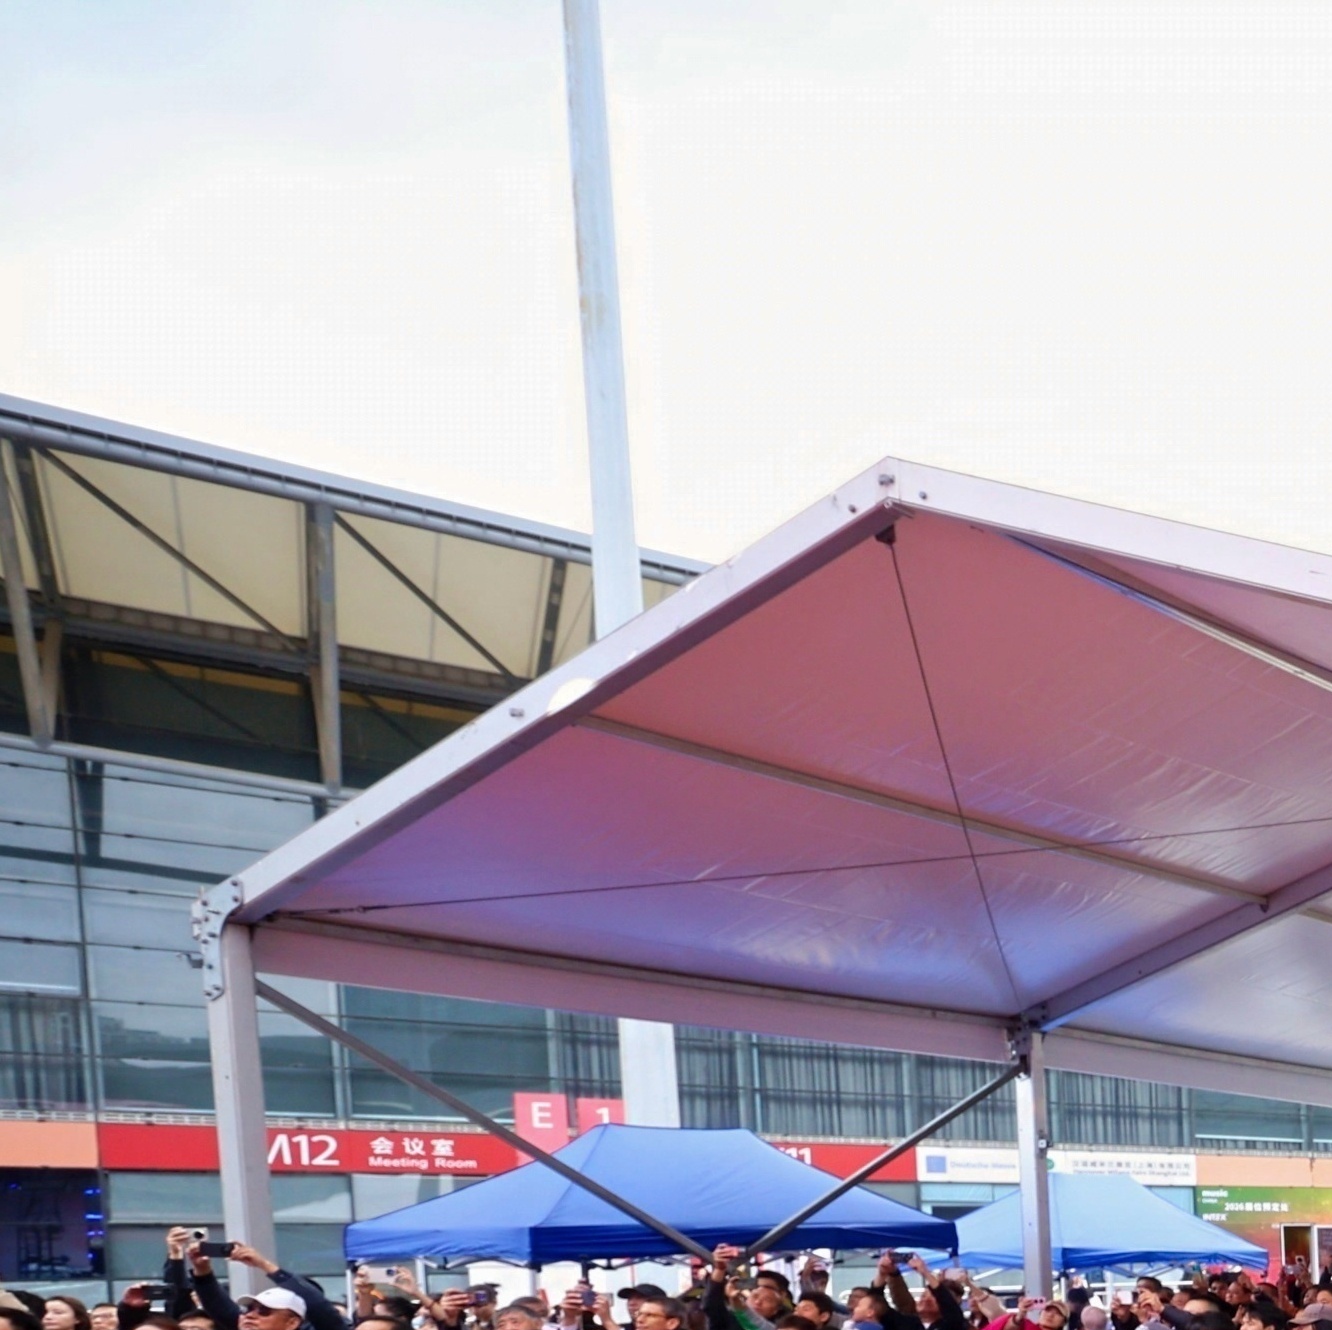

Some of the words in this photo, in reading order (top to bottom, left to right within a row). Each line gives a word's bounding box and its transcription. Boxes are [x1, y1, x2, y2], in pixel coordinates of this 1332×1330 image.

[531, 1101, 553, 1128] E
[369, 1136, 455, 1157] 会议室
[368, 1156, 429, 1170] Meeting
[434, 1157, 478, 1169] Room
[950, 1160, 988, 1172] Deutsche
